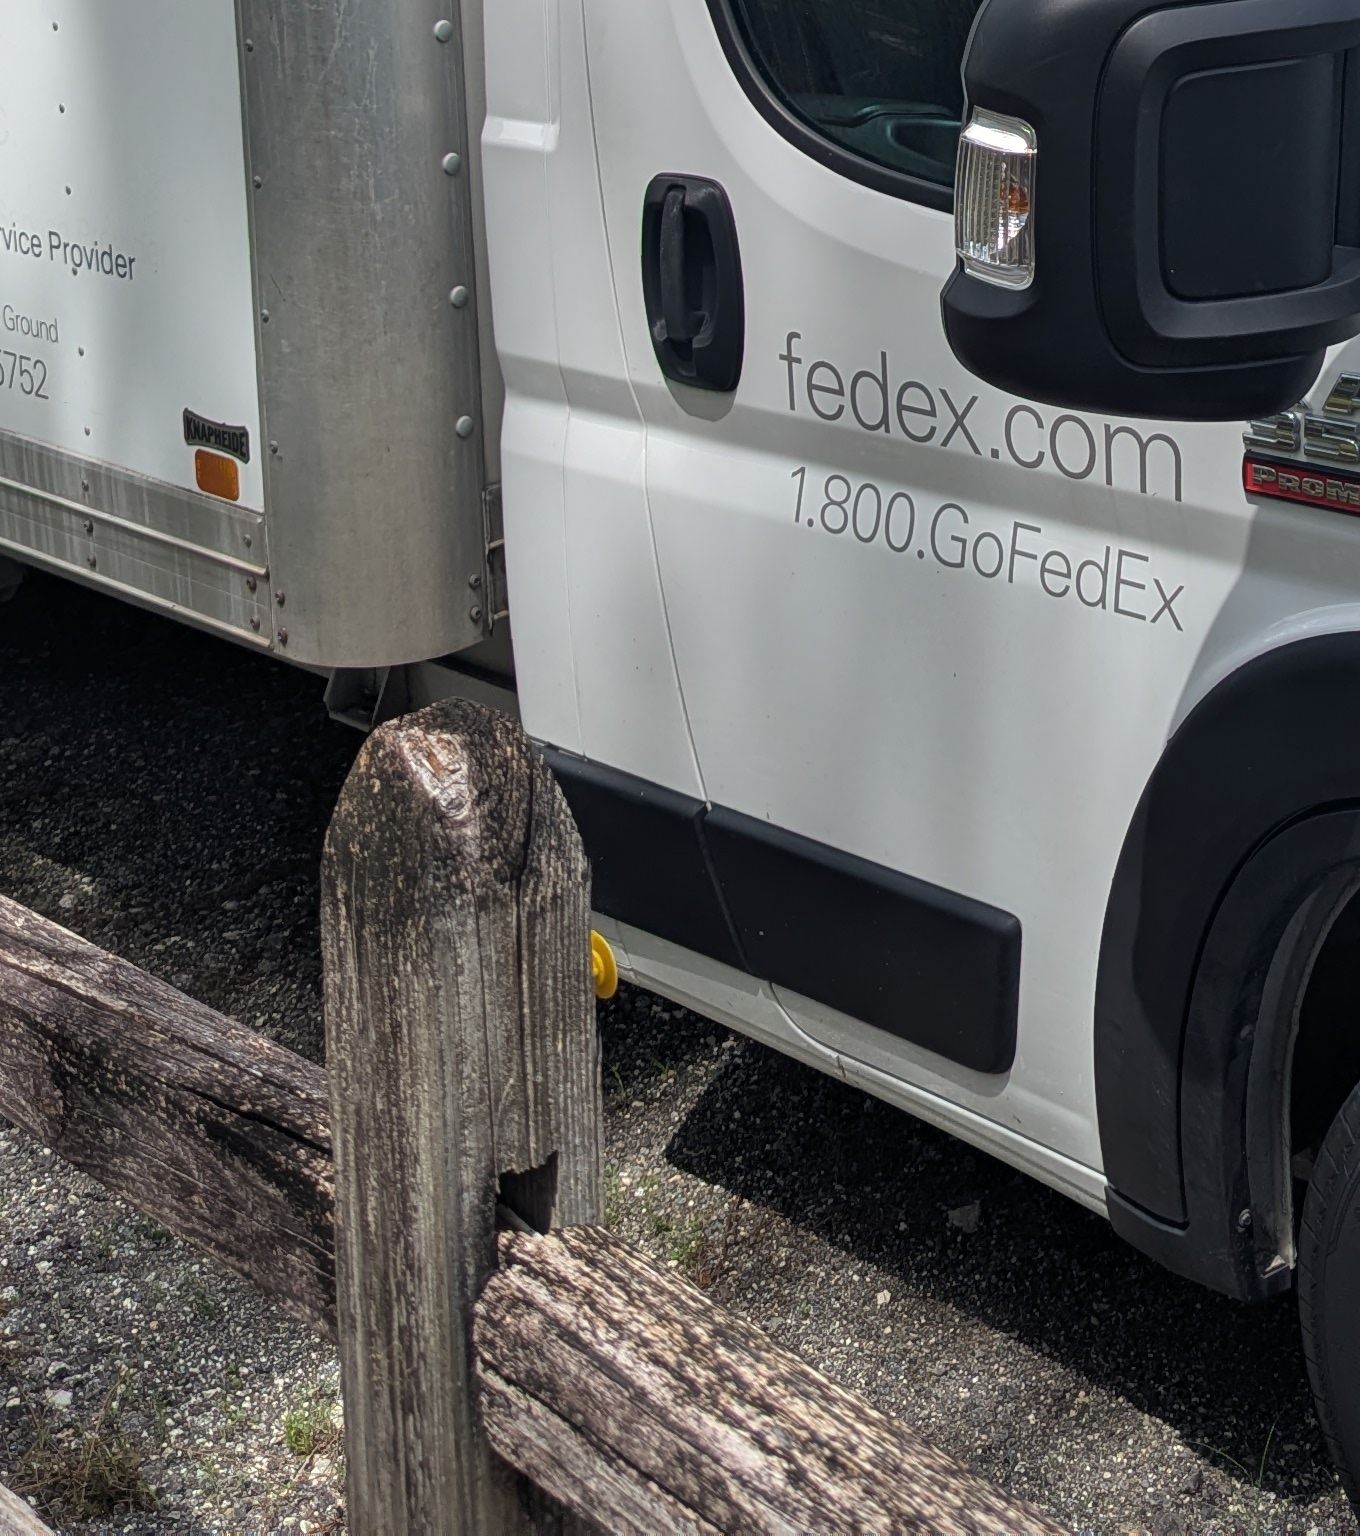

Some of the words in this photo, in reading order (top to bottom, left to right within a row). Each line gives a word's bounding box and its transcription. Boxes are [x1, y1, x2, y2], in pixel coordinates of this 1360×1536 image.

[48, 229, 137, 281] Provider
[2, 303, 60, 345] Ground
[185, 415, 247, 458] KNAPHEIDE
[778, 330, 1185, 503] fedex.com
[789, 465, 1186, 633] 1.800.GoFedEx
